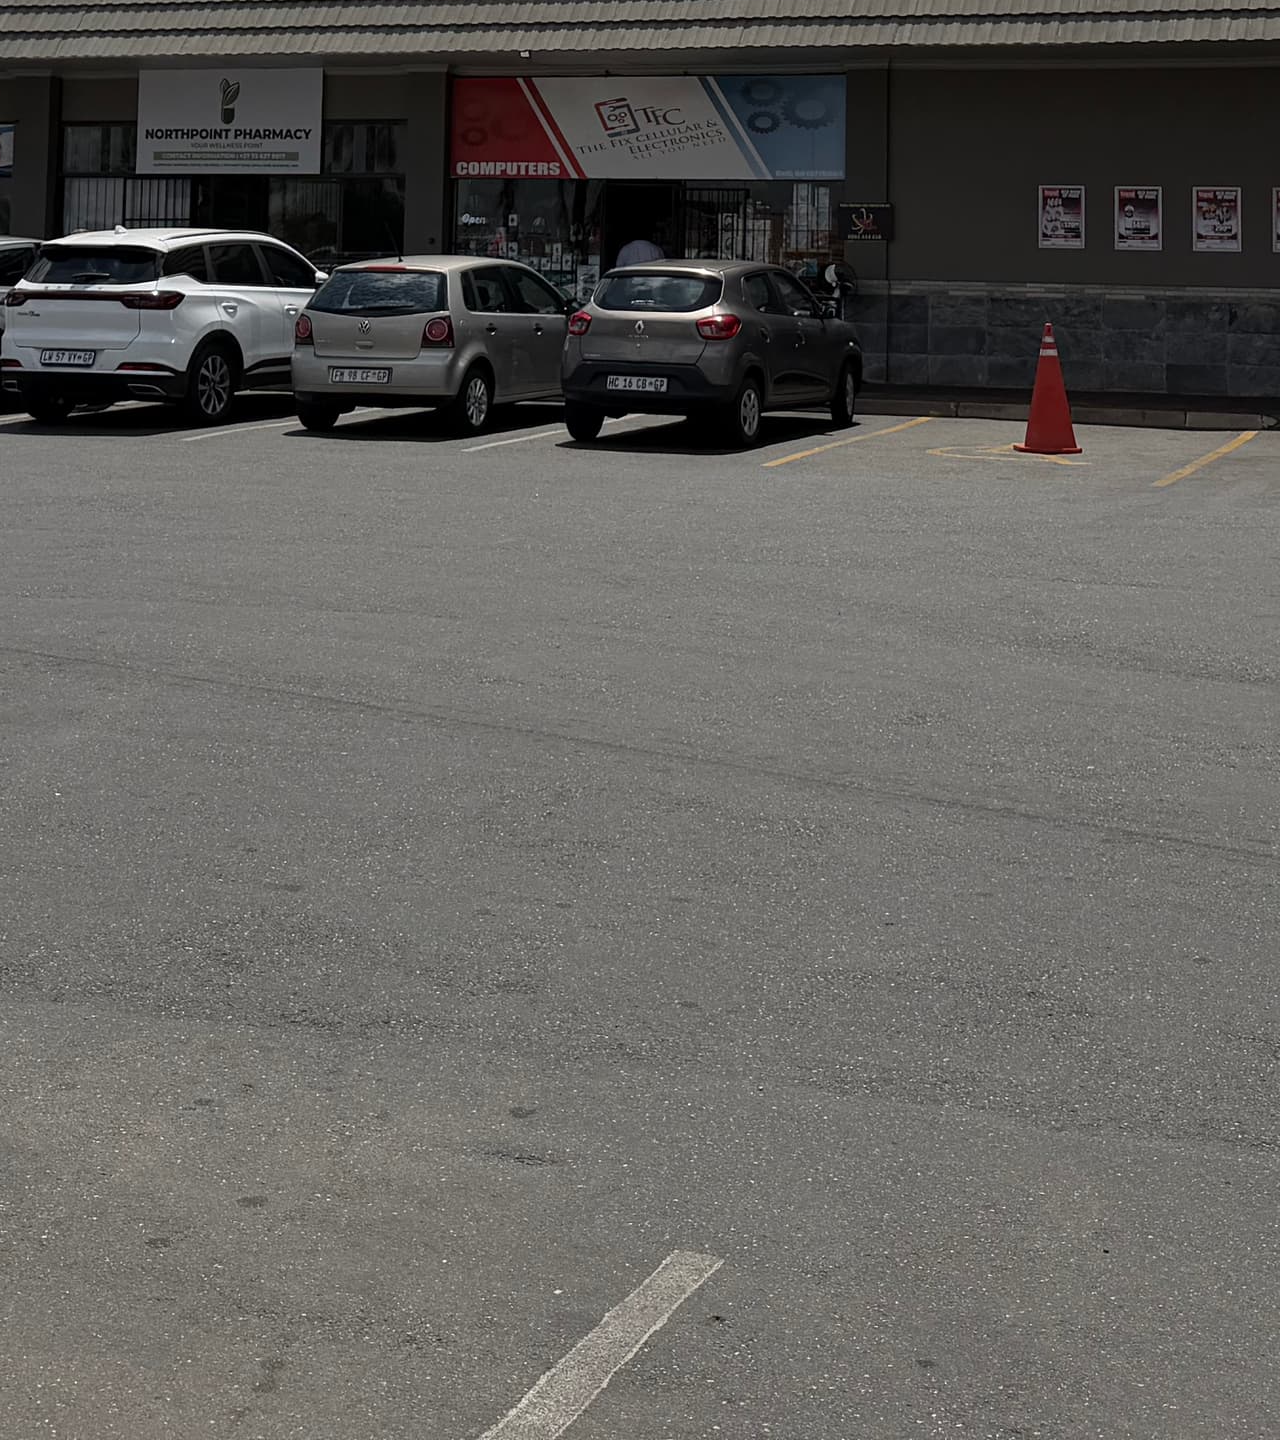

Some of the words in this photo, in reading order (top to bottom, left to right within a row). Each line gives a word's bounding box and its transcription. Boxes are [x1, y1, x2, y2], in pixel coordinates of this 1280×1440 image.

[634, 106, 685, 126] TFC
[145, 128, 231, 140] NORTHPOINT
[234, 128, 312, 140] PHARMACY
[577, 143, 607, 155] THE
[609, 137, 633, 149] FIX
[635, 123, 702, 143] CELLULAR
[705, 119, 719, 128] &
[629, 128, 723, 155] ELECTRONICS
[456, 161, 561, 176] COMPUTERS
[461, 212, 487, 225] Open
[82, 352, 93, 363] GP
[360, 370, 371, 381] CF
[376, 371, 387, 382] GP
[608, 377, 620, 388] HC
[623, 378, 633, 389] 16
[636, 378, 647, 389] CB
[654, 379, 665, 391] GP
